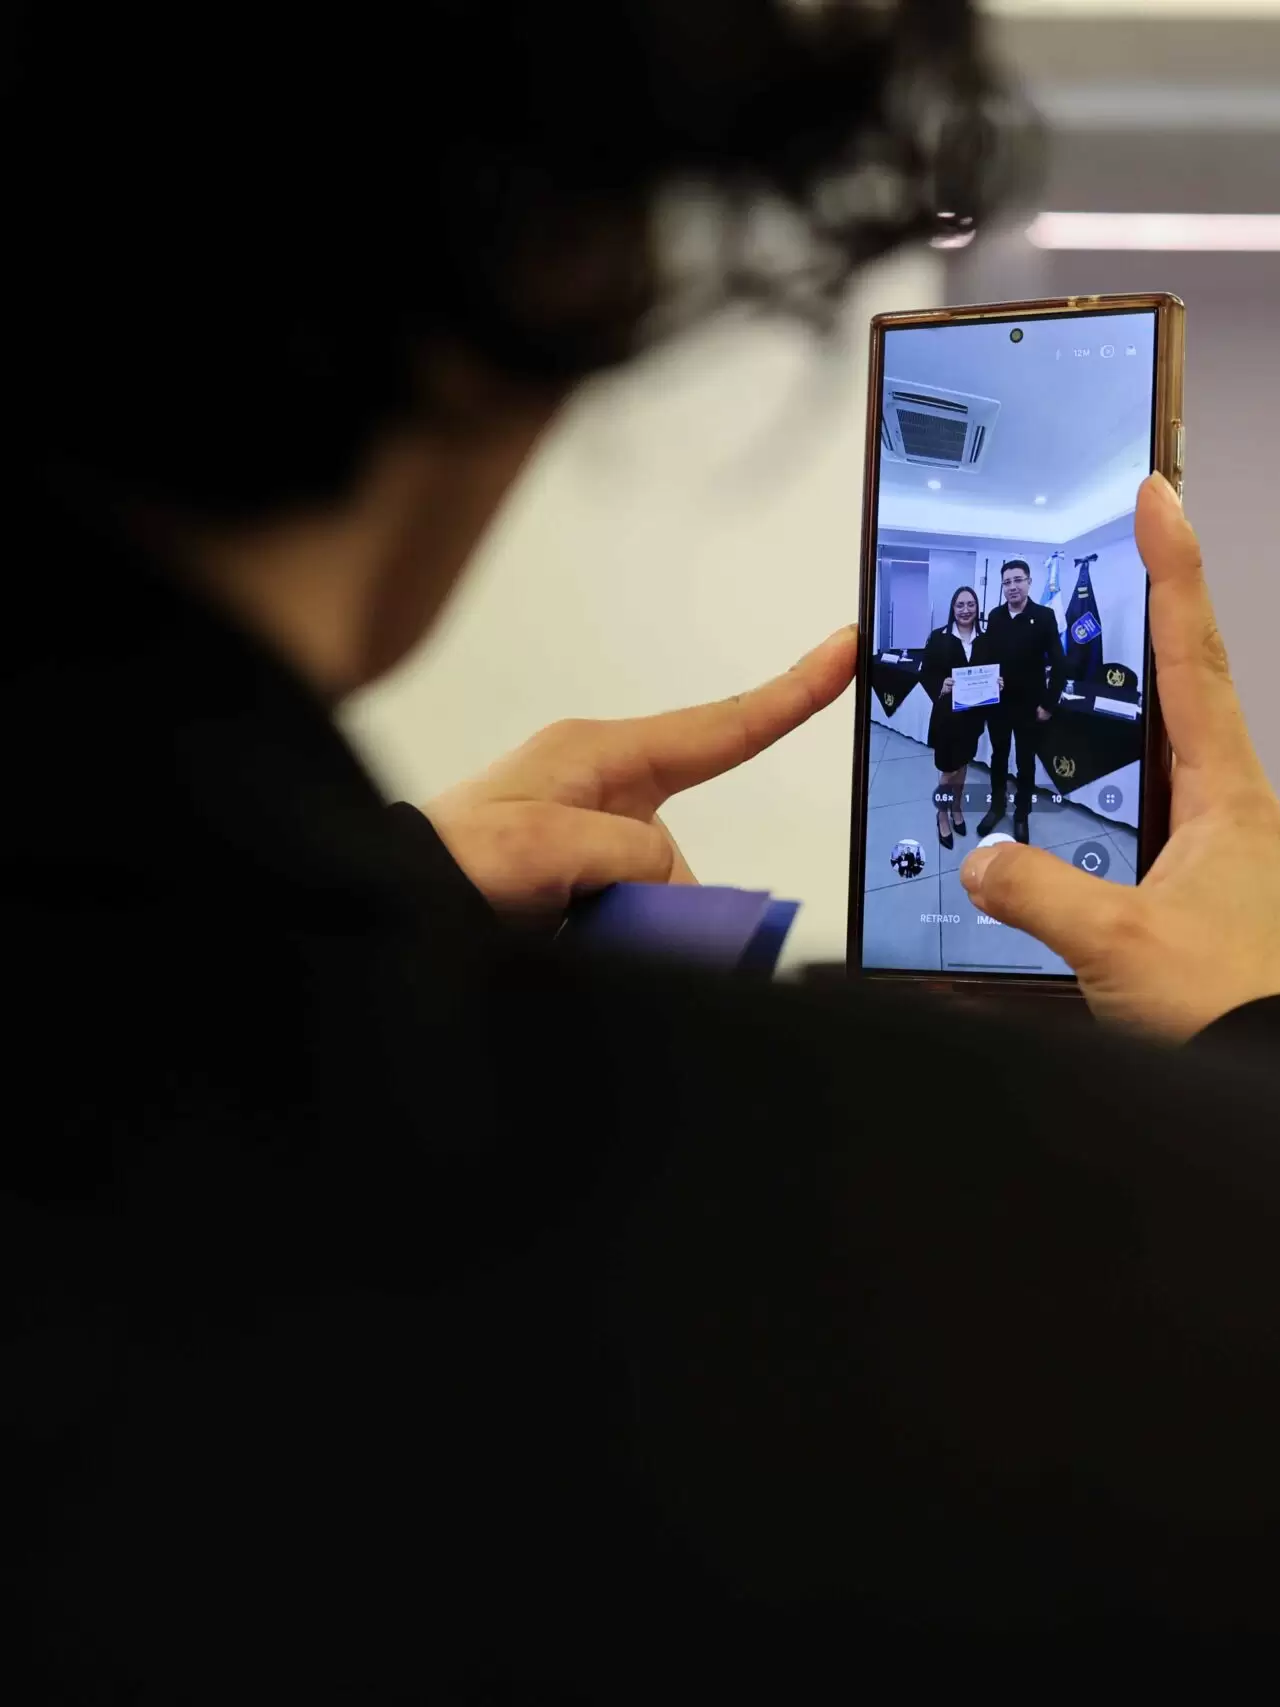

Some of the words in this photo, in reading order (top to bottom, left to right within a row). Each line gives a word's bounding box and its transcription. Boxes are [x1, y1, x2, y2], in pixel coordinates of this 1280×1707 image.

[965, 794, 970, 803] 1
[986, 794, 992, 803] 2
[1008, 794, 1015, 803] 3
[1031, 794, 1038, 803] 5
[1052, 794, 1062, 803] 10
[920, 914, 960, 924] RETRATO
